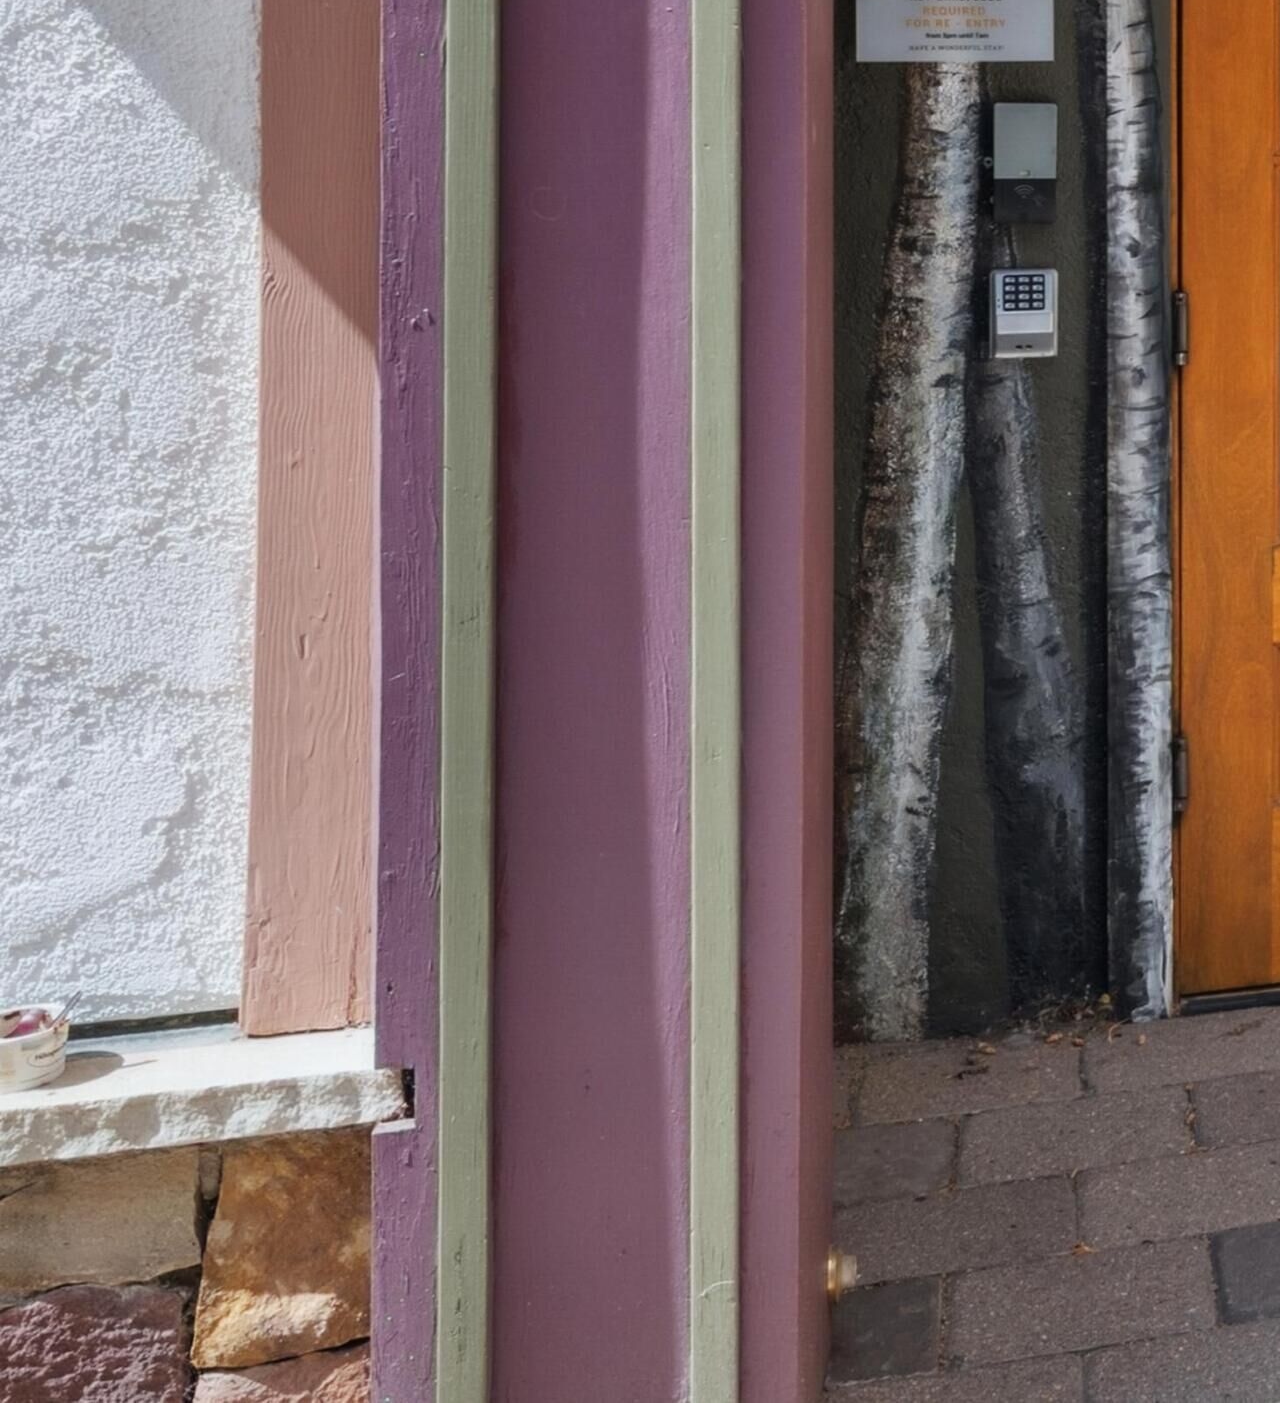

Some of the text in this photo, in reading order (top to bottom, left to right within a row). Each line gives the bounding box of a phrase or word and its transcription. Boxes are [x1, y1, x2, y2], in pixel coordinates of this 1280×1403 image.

[922, 6, 986, 15] REQUIRED
[905, 19, 930, 28] FOR
[966, 19, 1006, 28] ENTRY
